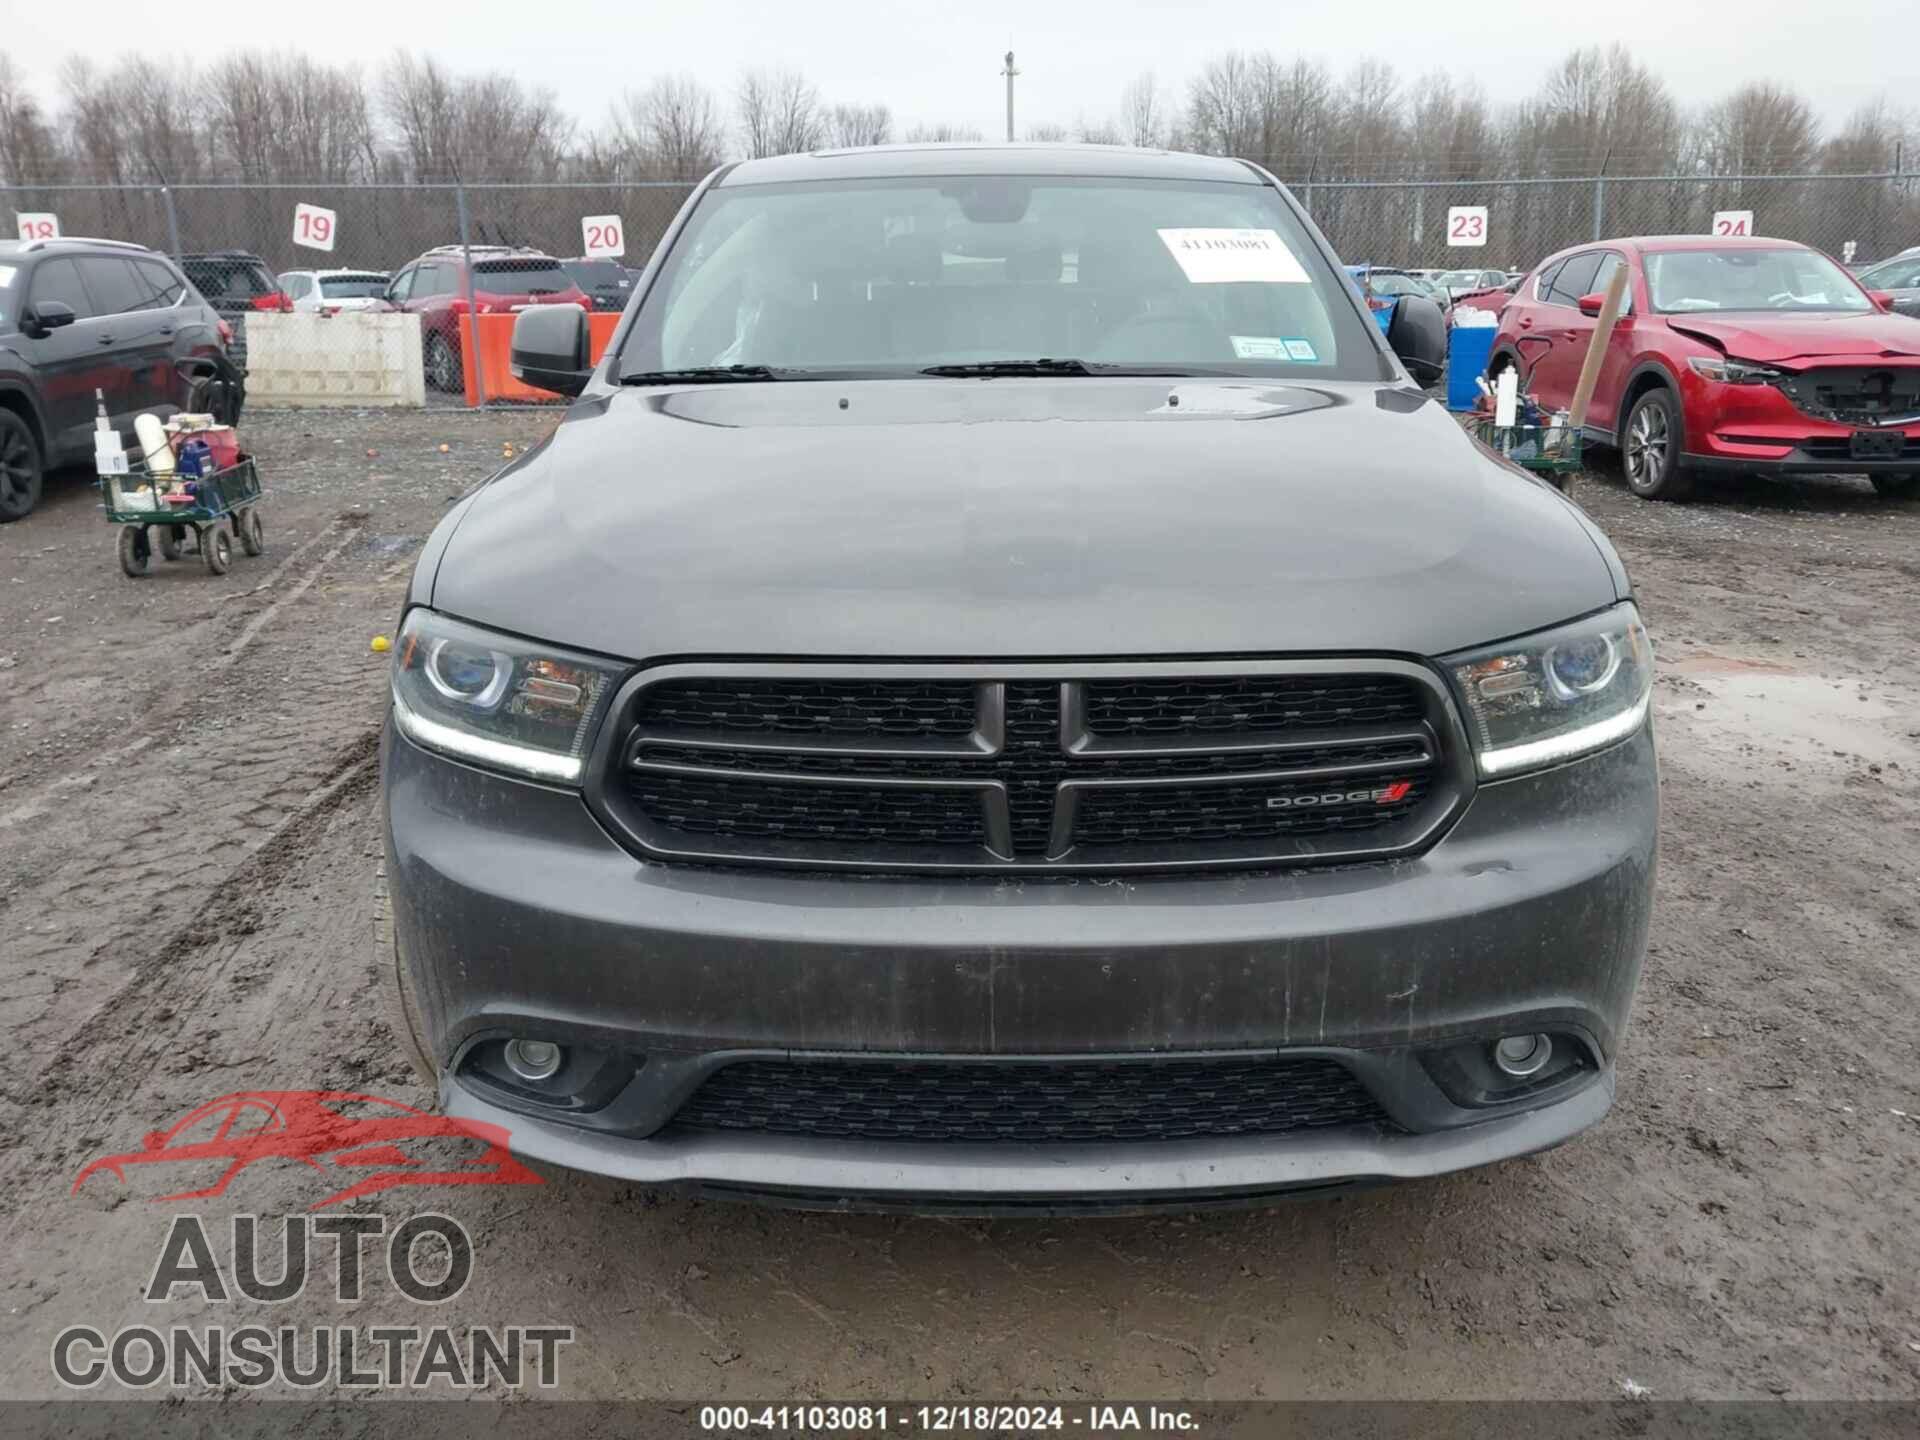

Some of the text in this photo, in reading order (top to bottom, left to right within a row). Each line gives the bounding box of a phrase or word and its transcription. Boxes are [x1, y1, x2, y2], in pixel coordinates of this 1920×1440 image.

[22, 221, 54, 238] 18
[298, 213, 331, 242] 19
[587, 225, 619, 249] 20
[1452, 216, 1482, 238] 23
[1718, 220, 1746, 235] 24
[1266, 788, 1393, 808] DODGE
